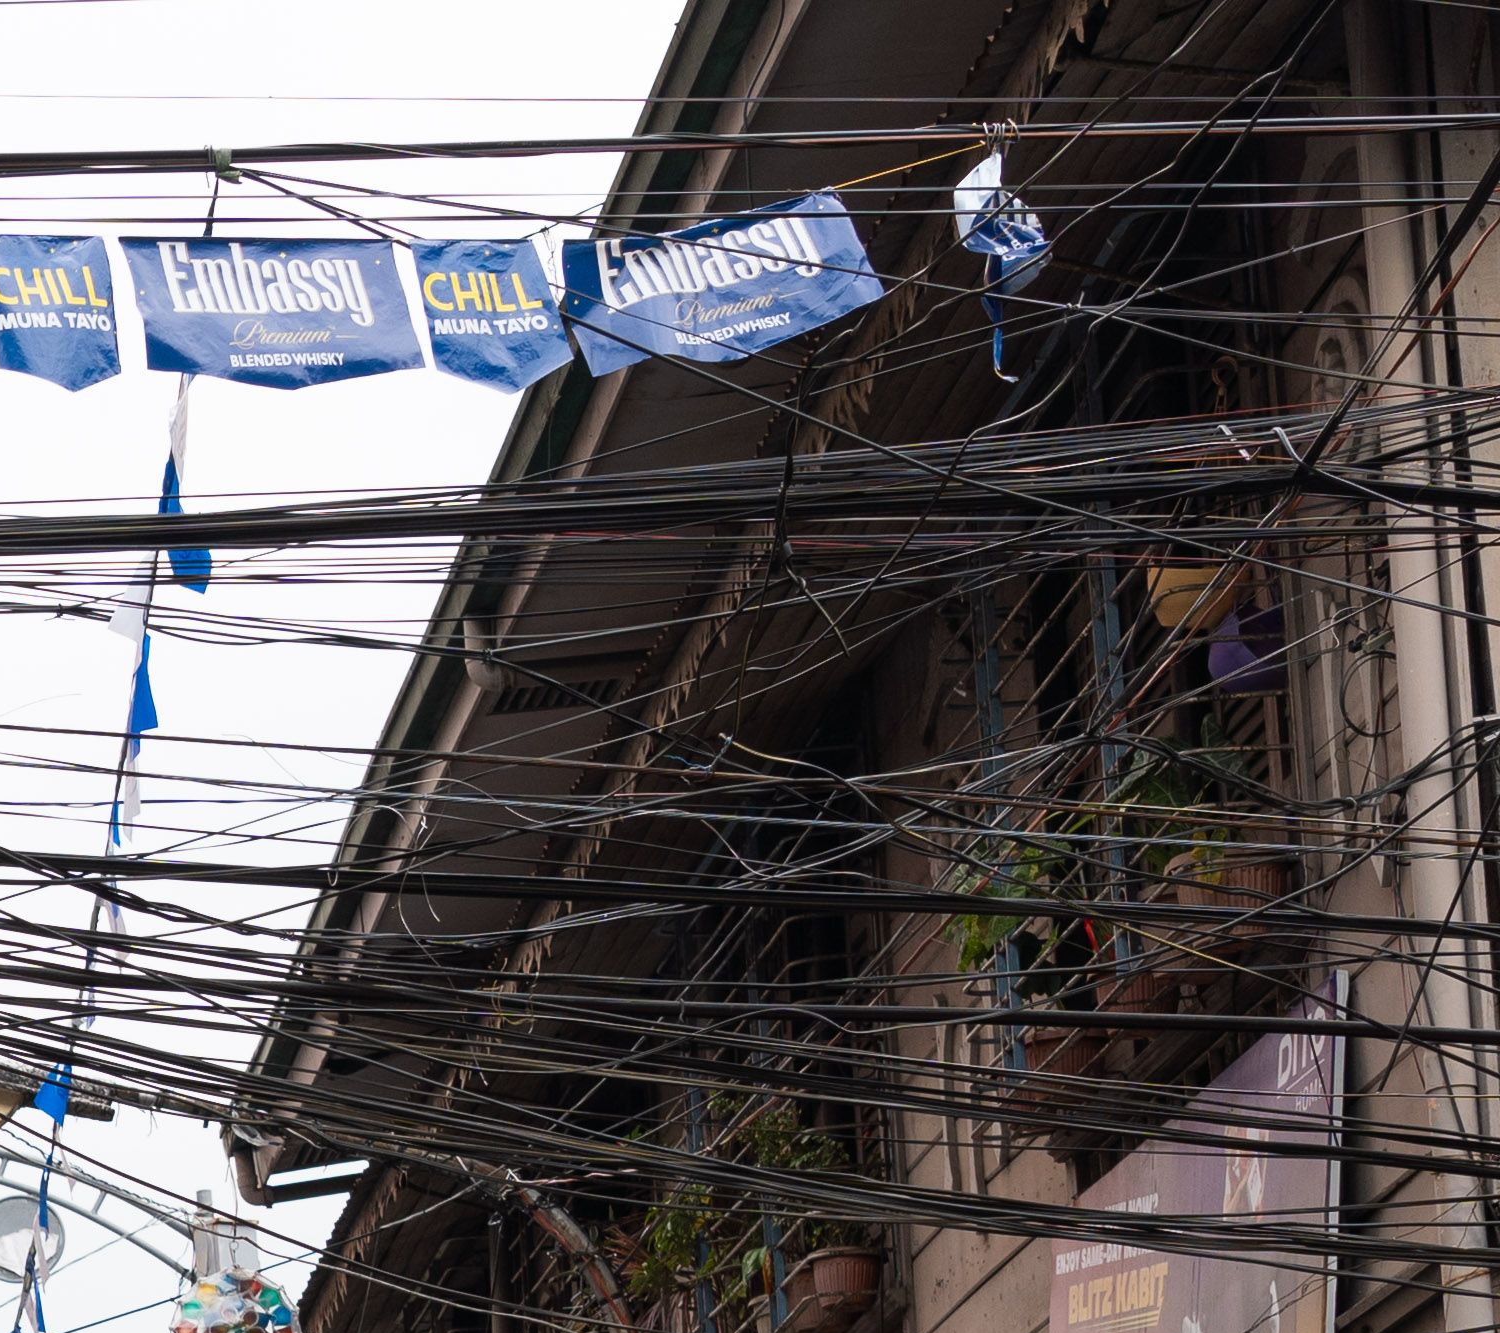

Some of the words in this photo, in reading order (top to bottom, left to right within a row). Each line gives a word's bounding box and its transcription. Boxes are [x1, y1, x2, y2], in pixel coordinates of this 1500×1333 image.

[157, 241, 376, 328] Embassy
[423, 271, 543, 313] CHILL
[62, 311, 112, 333] TAYO
[229, 319, 332, 349] Premium
[434, 318, 494, 336] MUNA
[495, 313, 549, 335] TAYO
[675, 321, 735, 346] BLENDED
[735, 313, 792, 336] WHISKY
[229, 353, 292, 368] BLENDED
[291, 352, 345, 367] WHISKY
[1068, 1276, 1113, 1325] BLITZ
[1115, 1261, 1169, 1314] KABIT
